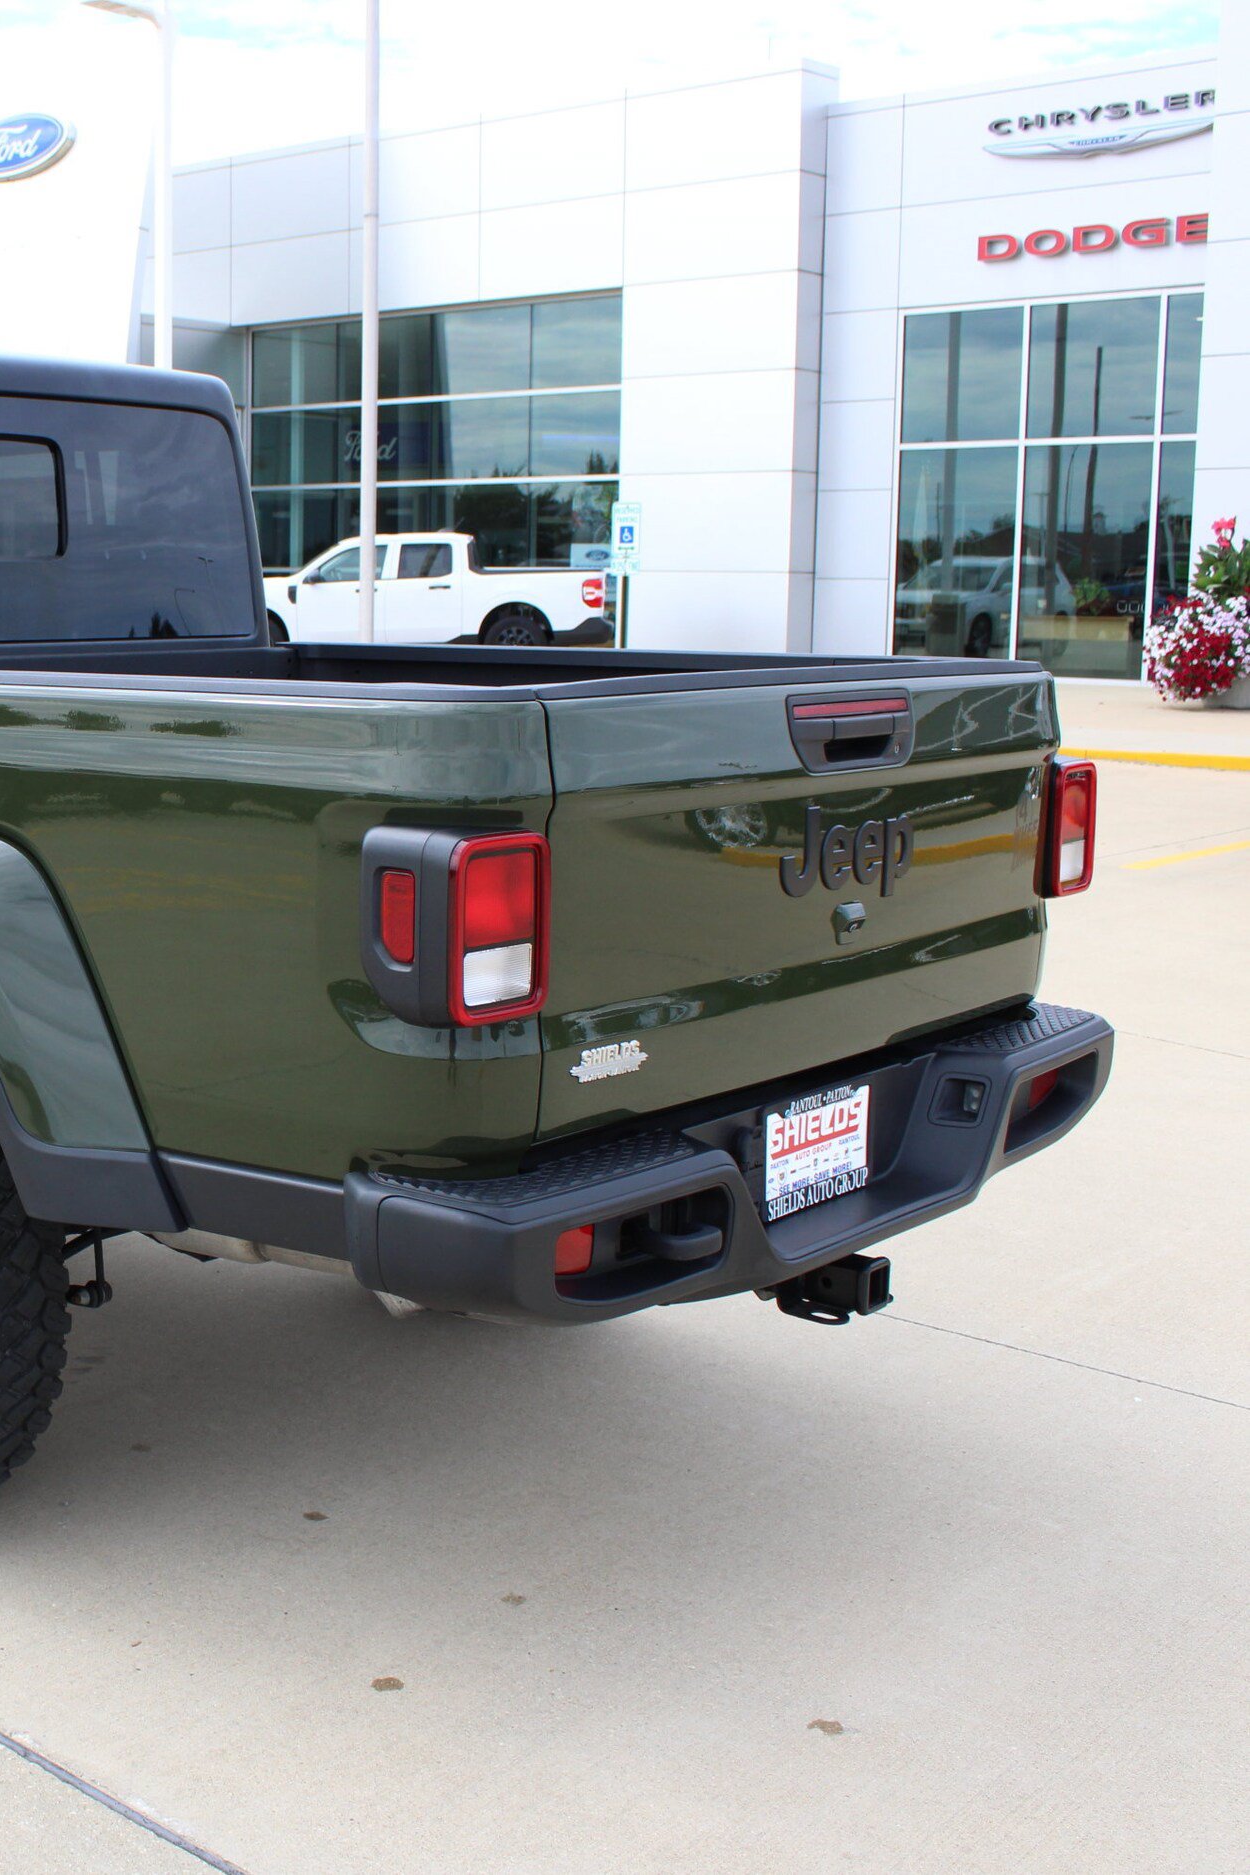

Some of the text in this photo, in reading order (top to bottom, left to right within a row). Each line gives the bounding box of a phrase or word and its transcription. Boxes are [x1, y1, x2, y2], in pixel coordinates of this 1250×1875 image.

[988, 88, 1216, 136] CHRYSLER
[977, 212, 1210, 262] DODGE
[780, 806, 914, 897] Jeep
[581, 1040, 641, 1067] SHIELDS
[790, 1085, 852, 1114] RANTOUL PAXTON
[769, 1100, 862, 1153] SHIELDS
[795, 1142, 832, 1161] AUTO GROUP
[768, 1166, 868, 1222] SHIELDS AUTO GROUP
[779, 1184, 790, 1195] SEE
[792, 1176, 810, 1189] MORE
[814, 1171, 830, 1182] SAVE
